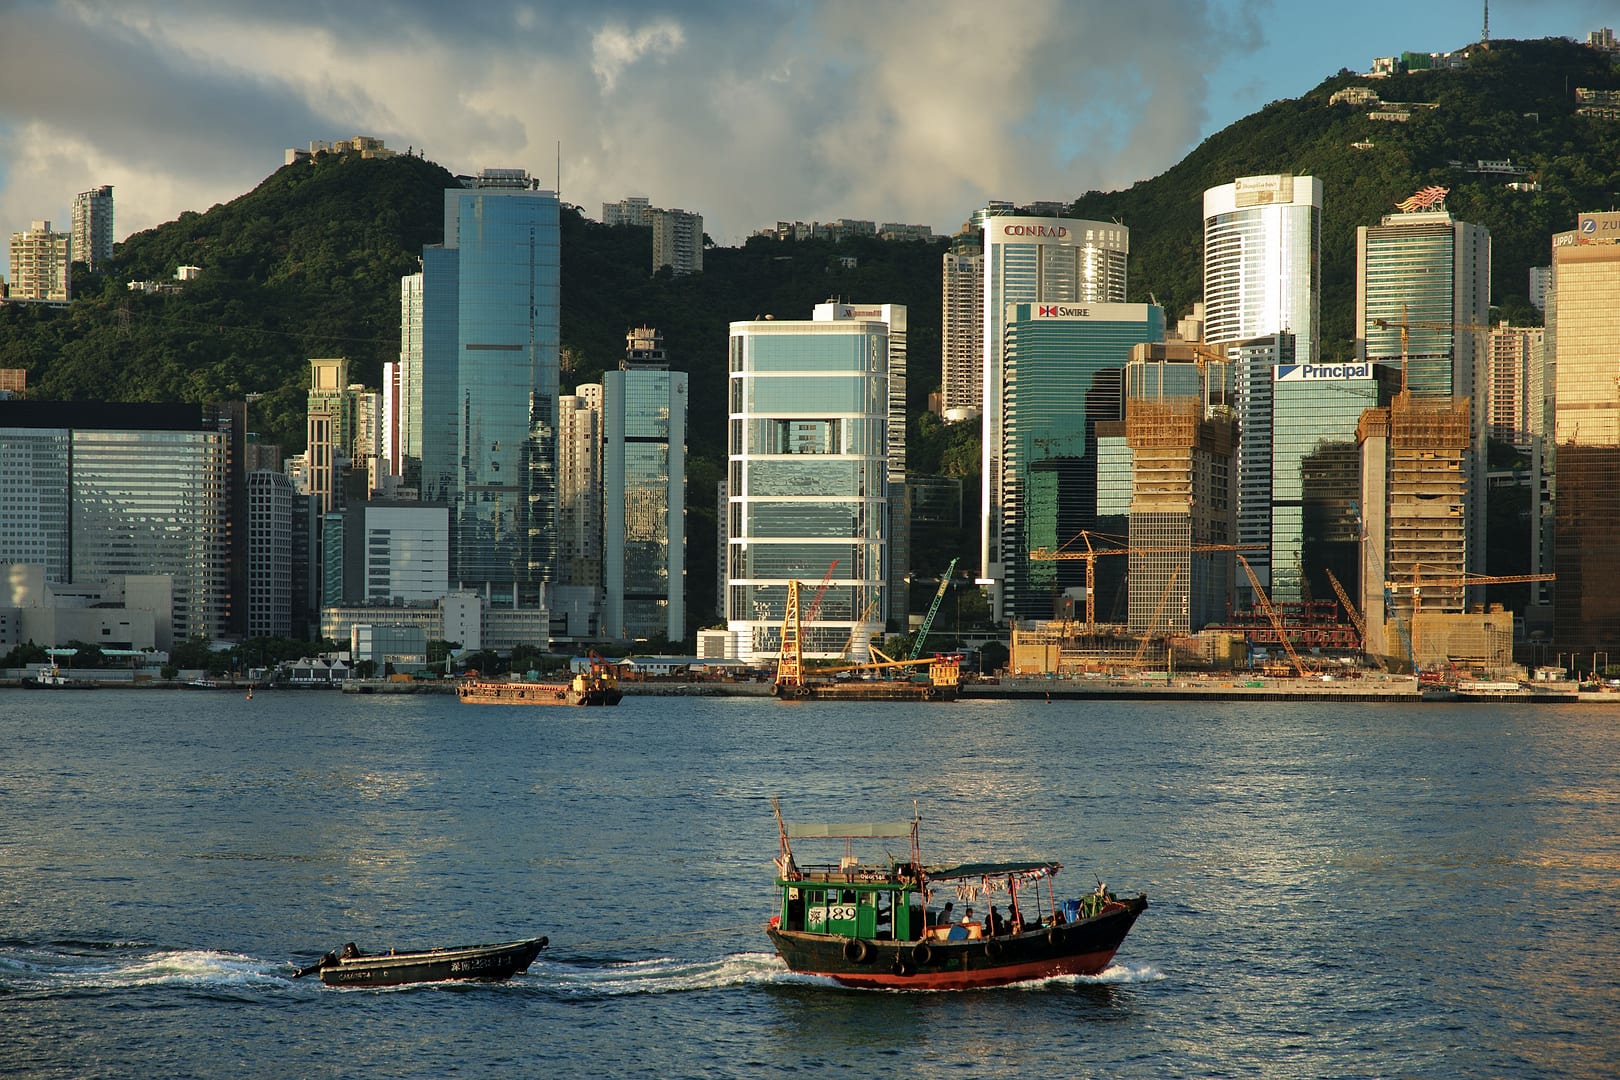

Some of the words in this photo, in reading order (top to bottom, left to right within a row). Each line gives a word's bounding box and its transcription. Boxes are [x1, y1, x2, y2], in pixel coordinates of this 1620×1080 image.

[1004, 225, 1067, 238] CONRAD
[1602, 221, 1620, 230] ZU
[1553, 234, 1573, 247] LIPPO
[1302, 363, 1369, 379] Principal
